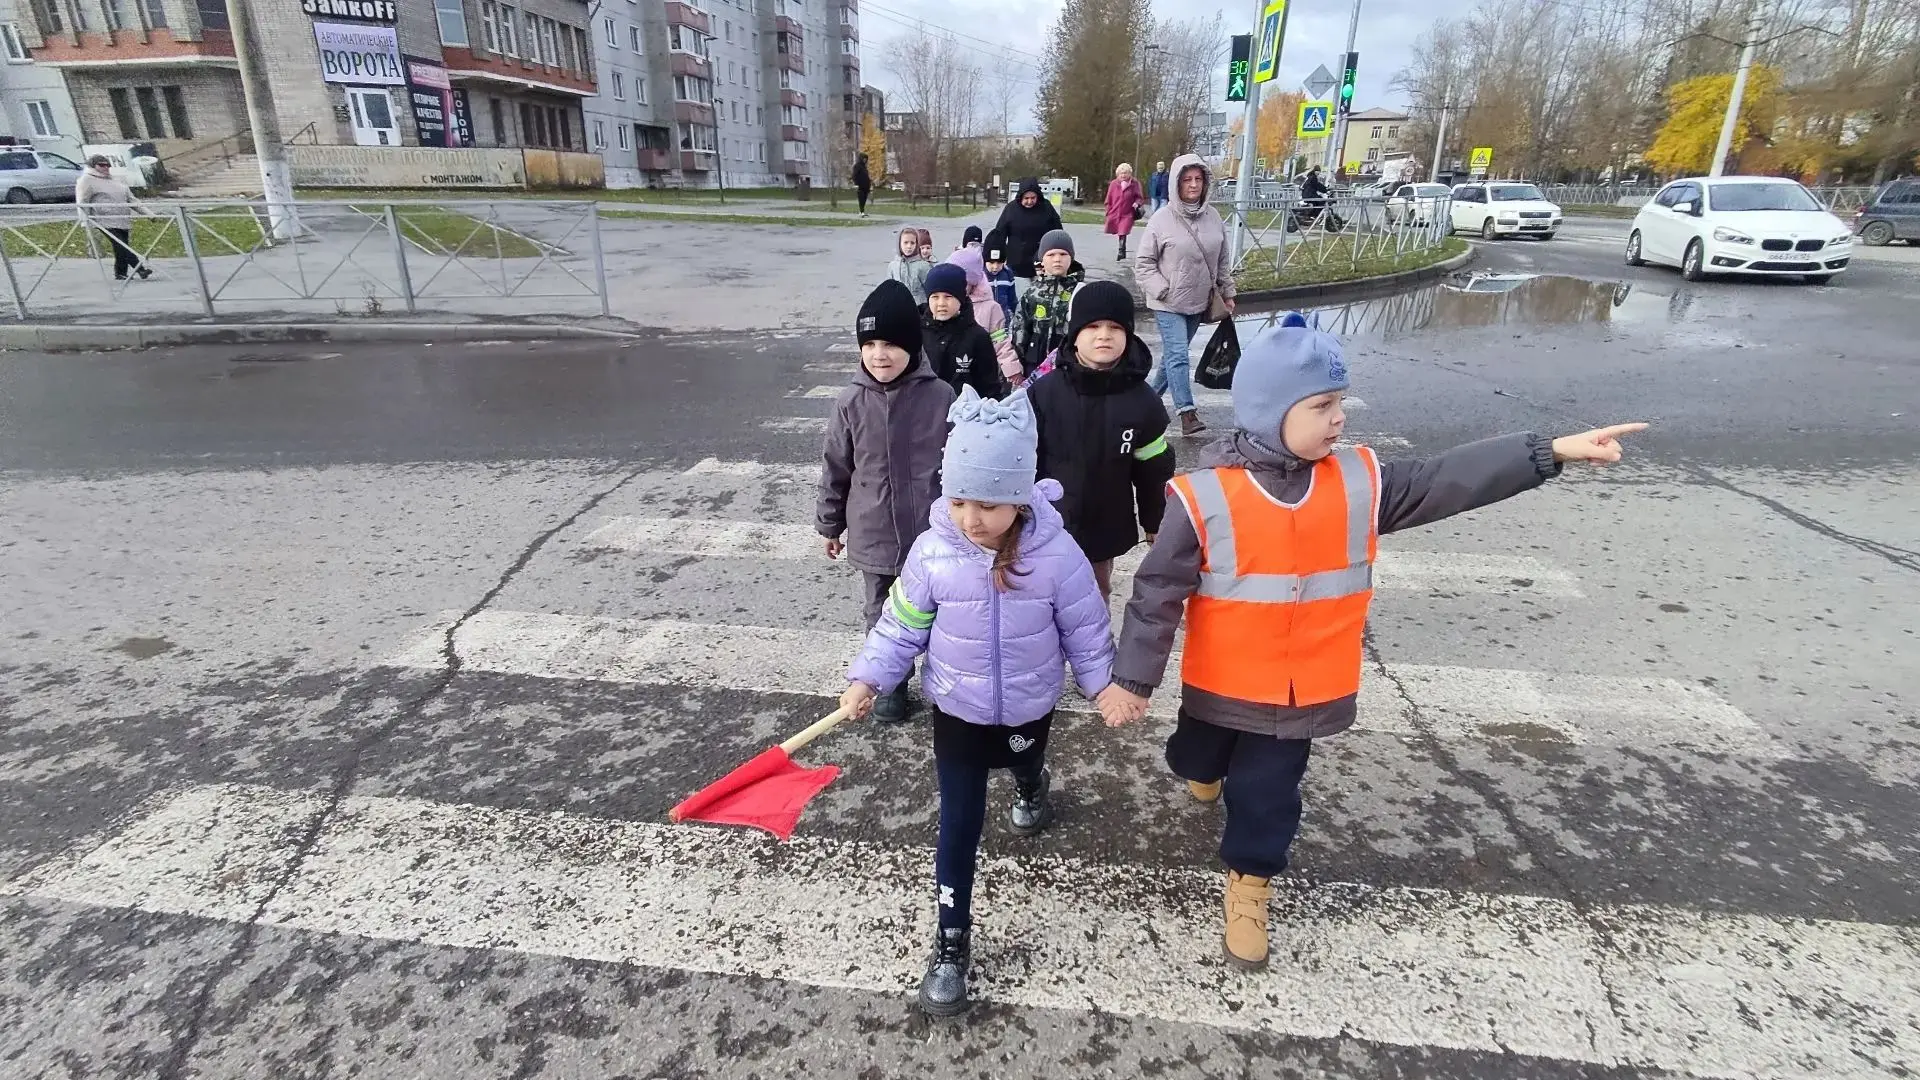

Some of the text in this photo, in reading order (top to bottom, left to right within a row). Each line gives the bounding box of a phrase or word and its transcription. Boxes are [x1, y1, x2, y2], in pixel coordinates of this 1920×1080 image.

[321, 31, 394, 47] АВТОМАТИЧЕСКИЕ
[322, 49, 402, 78] ВОРОТА
[1230, 60, 1249, 75] 30
[430, 174, 483, 184] МОНТАЖОМ
